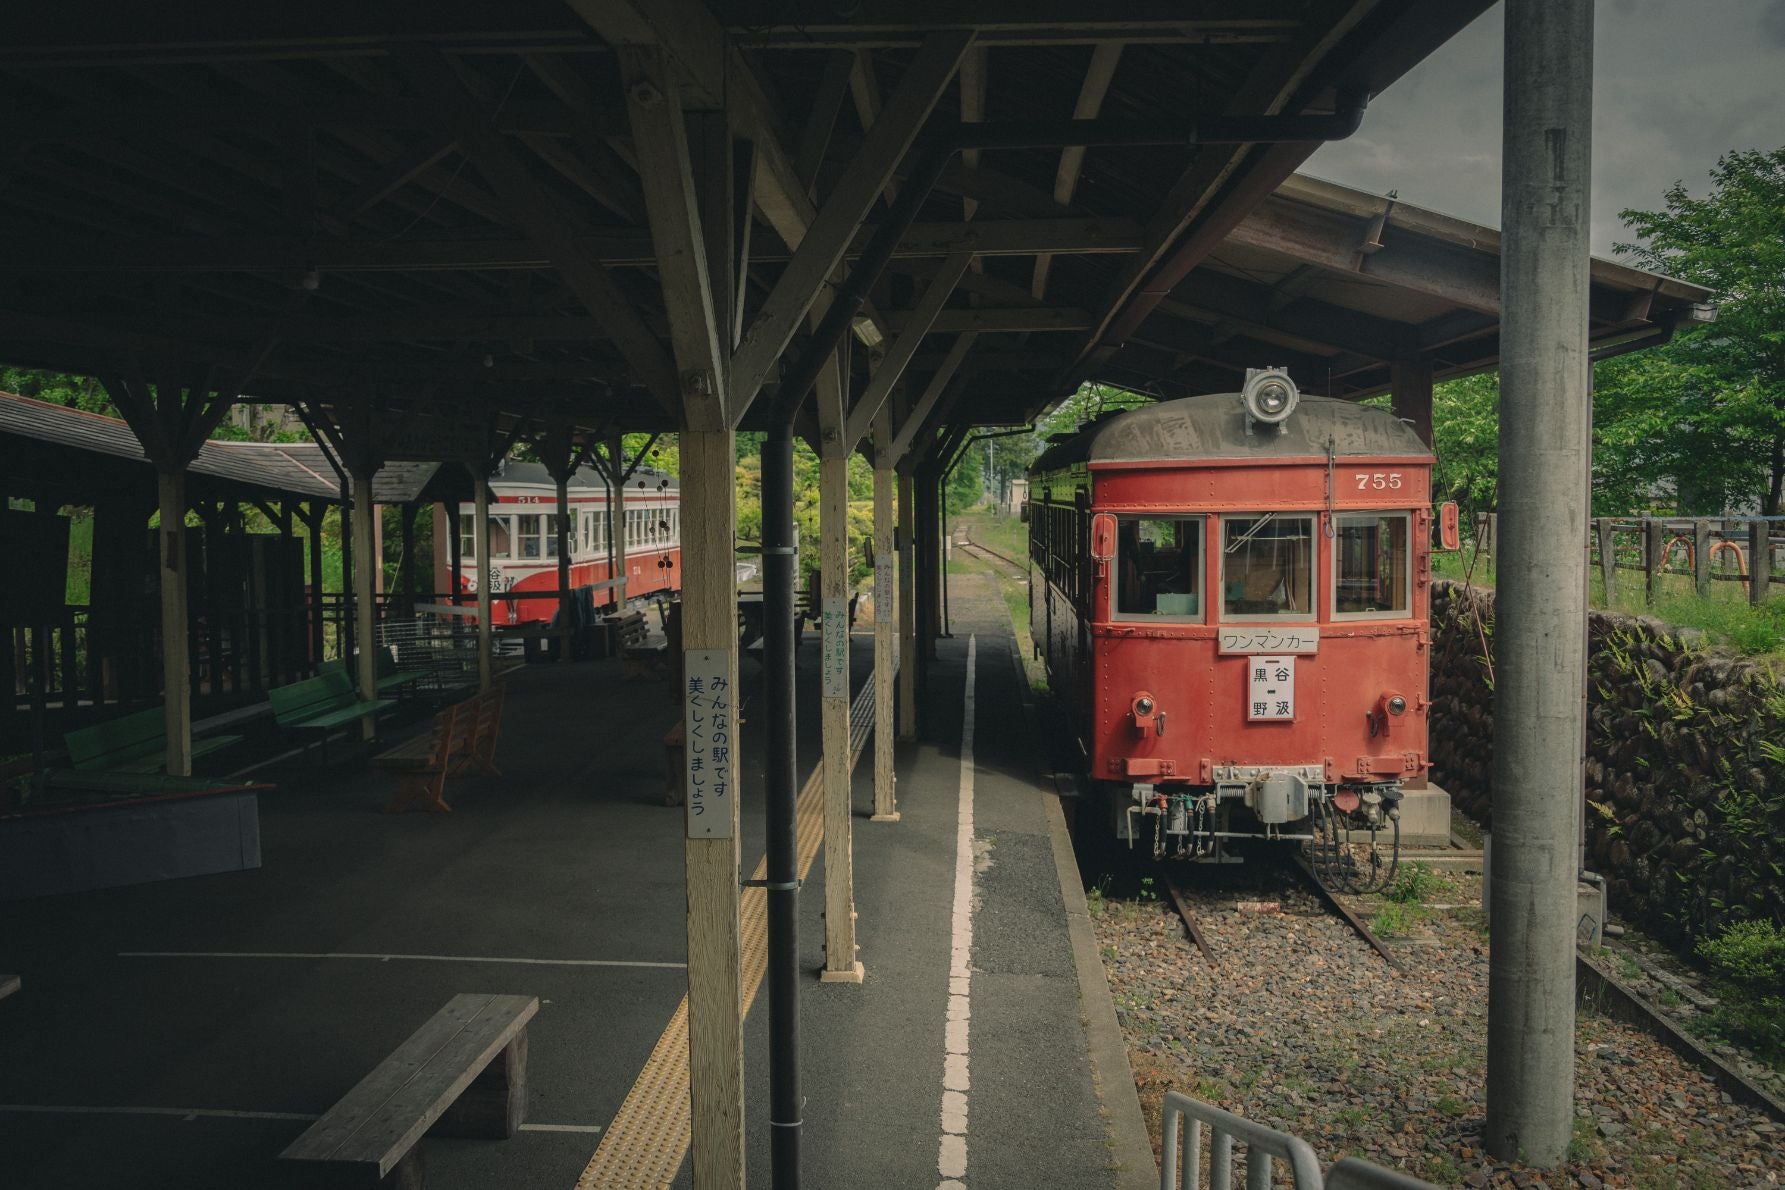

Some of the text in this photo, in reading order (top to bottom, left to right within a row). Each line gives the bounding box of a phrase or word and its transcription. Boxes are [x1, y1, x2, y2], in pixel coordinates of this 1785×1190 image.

[1355, 473, 1402, 490] 755
[517, 496, 540, 504] 514
[1223, 634, 1315, 649] ワンマンカー
[710, 676, 729, 797] みんなの駅です
[688, 677, 705, 815] 美くしくしましょう
